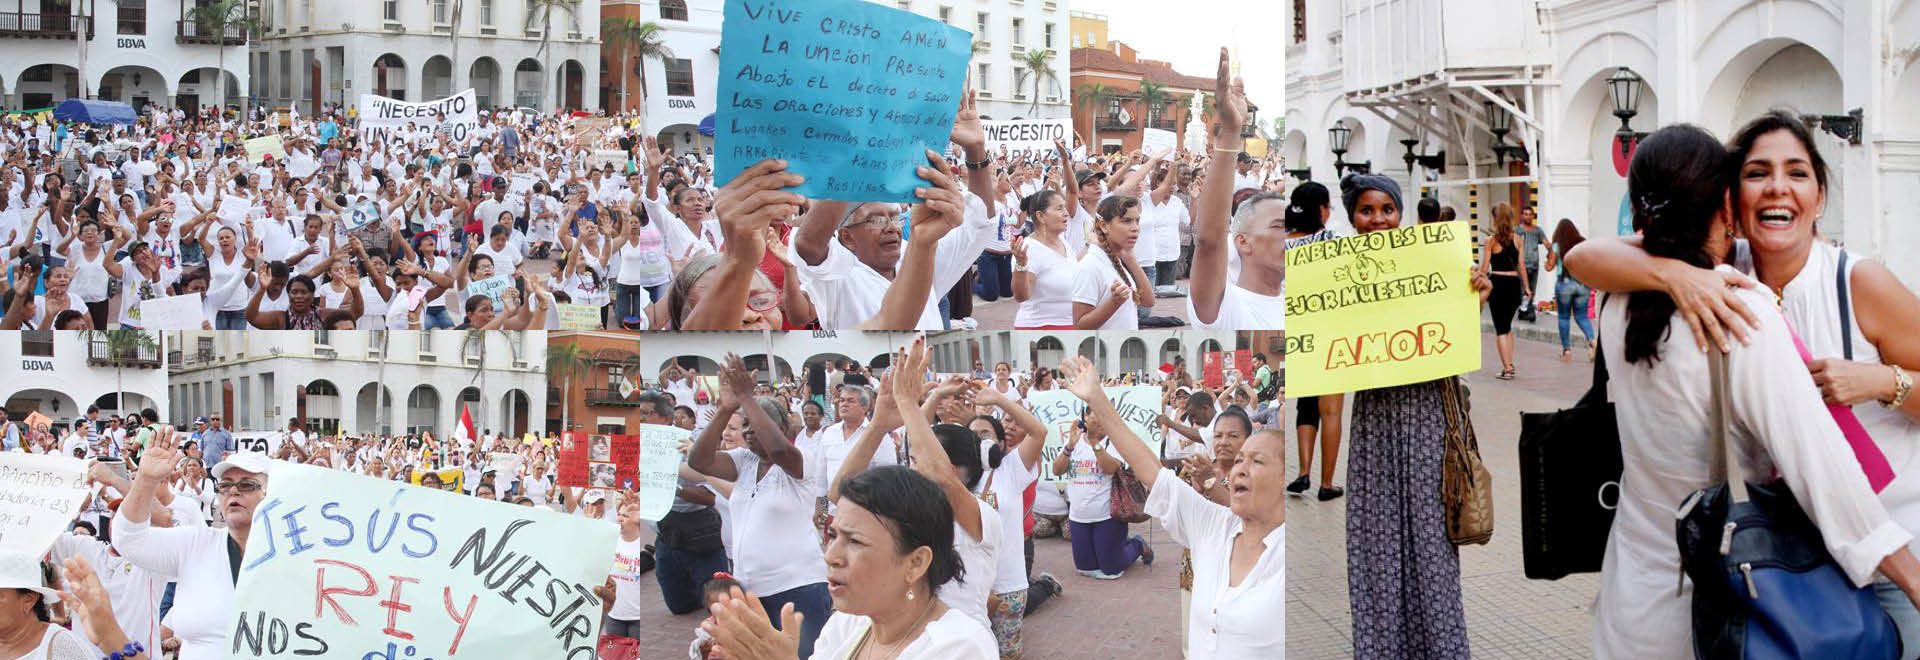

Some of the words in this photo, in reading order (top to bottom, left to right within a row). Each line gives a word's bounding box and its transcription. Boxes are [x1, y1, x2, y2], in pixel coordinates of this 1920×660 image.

[117, 38, 146, 49] BBVA
[761, 34, 789, 54] LA
[736, 64, 793, 87] Abajo
[668, 99, 695, 108] BBVA
[732, 92, 763, 110] Las
[1293, 232, 1385, 266] ABRAZO
[1390, 226, 1417, 249] ES
[1424, 223, 1455, 245] LA
[1340, 271, 1448, 308] MUESTRA
[812, 330, 838, 339] BBVA
[1285, 333, 1314, 355] DE
[1325, 321, 1452, 370] AMOR
[22, 360, 54, 371] BBVA
[245, 488, 438, 571] JESÚS
[449, 519, 600, 660] NUESTRO
[313, 559, 479, 656] REY
[232, 610, 329, 657] NOS
